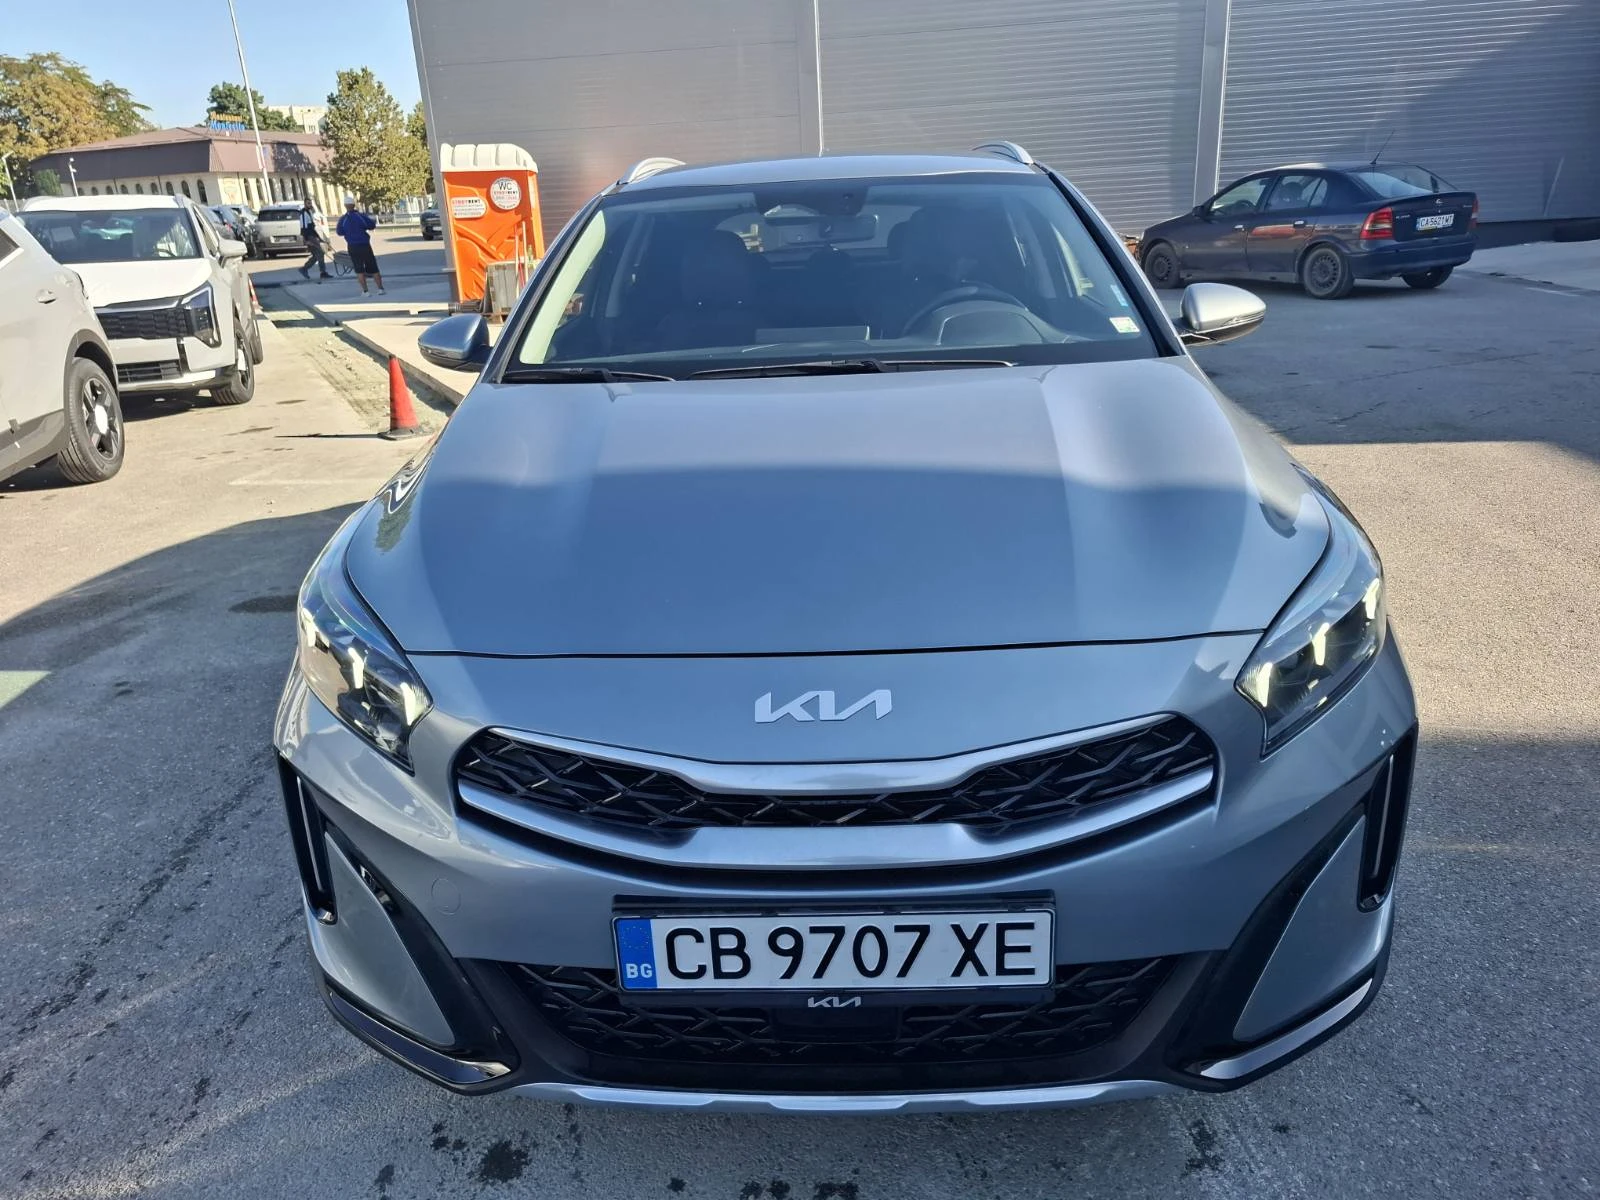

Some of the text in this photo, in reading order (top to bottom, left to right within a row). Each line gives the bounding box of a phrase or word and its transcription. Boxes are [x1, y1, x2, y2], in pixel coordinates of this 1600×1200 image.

[499, 182, 512, 190] WC
[754, 689, 892, 723] KIA
[665, 922, 1036, 980] CB 9707 XE
[625, 962, 653, 979] BG
